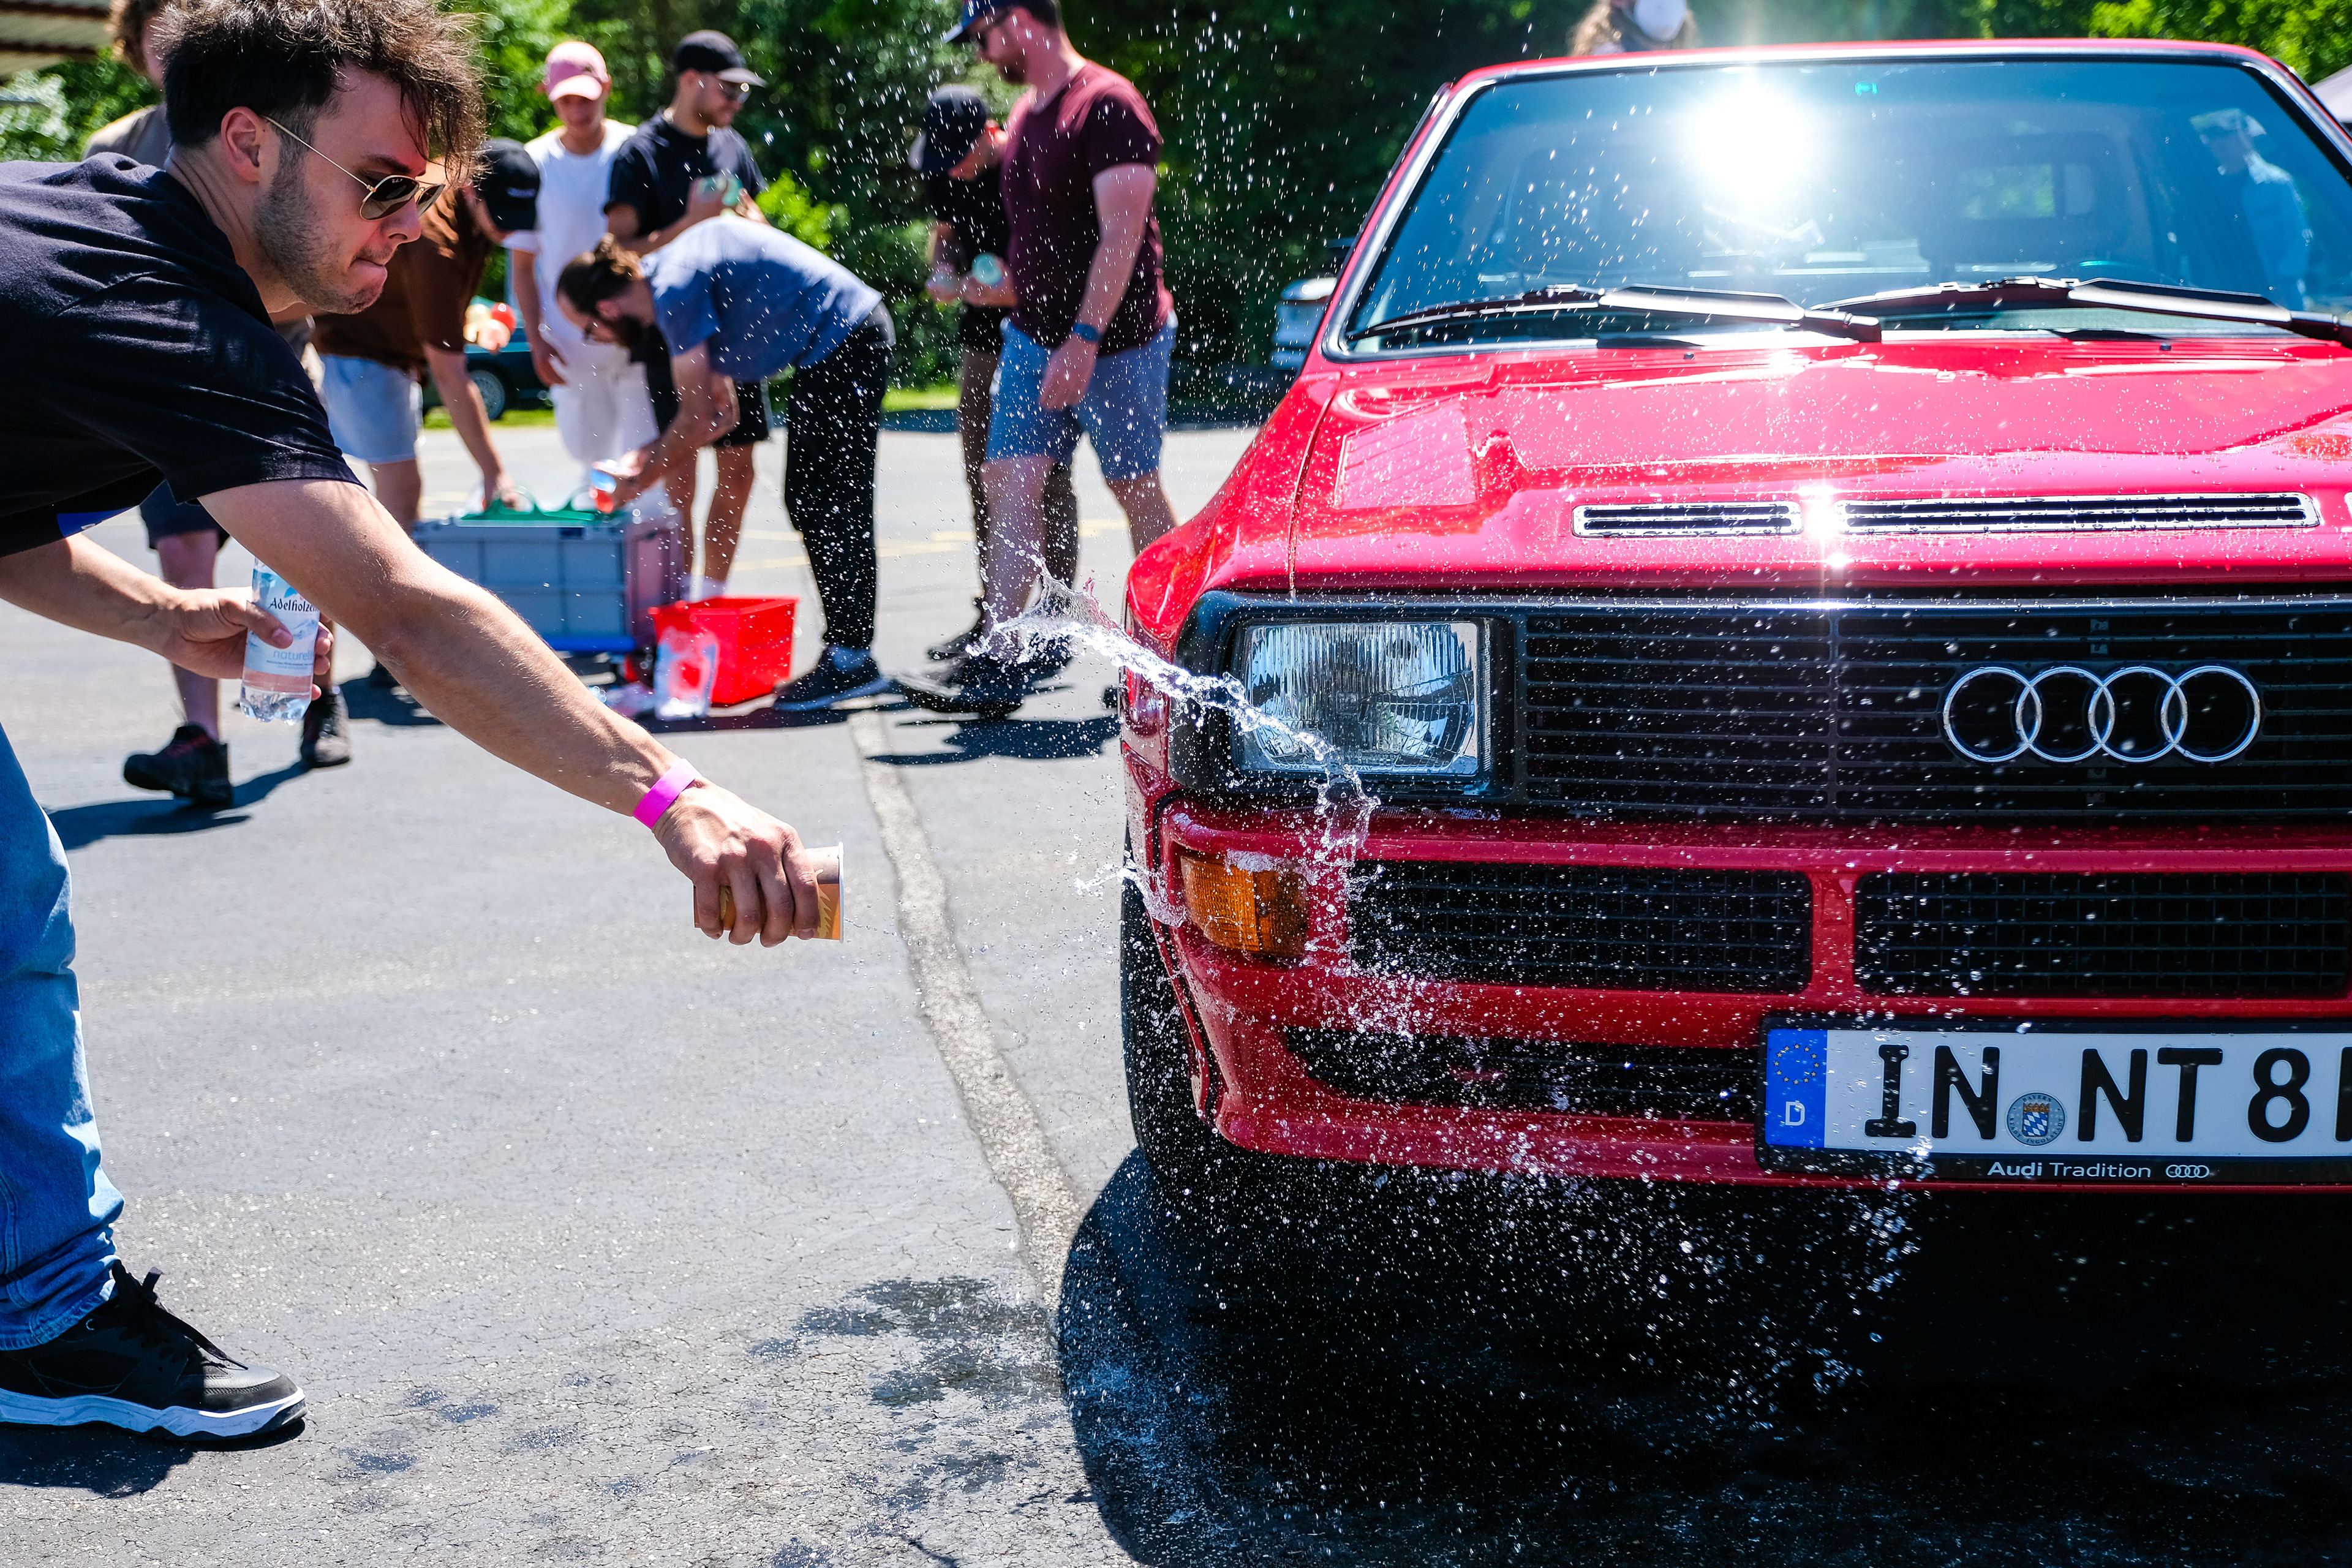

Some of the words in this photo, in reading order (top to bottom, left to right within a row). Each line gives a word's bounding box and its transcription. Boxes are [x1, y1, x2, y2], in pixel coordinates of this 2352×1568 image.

[268, 597, 318, 612] Adelholzen
[273, 650, 313, 661] naturell
[1864, 1044, 2000, 1140] IN
[2077, 1047, 2223, 1143] NT
[1785, 1101, 1806, 1126] D
[2010, 1117, 2022, 1138] STADT
[2026, 1118, 2064, 1144] INGOLSTADT
[1987, 1161, 2042, 1177] Audi
[2049, 1163, 2152, 1177] Tradition
